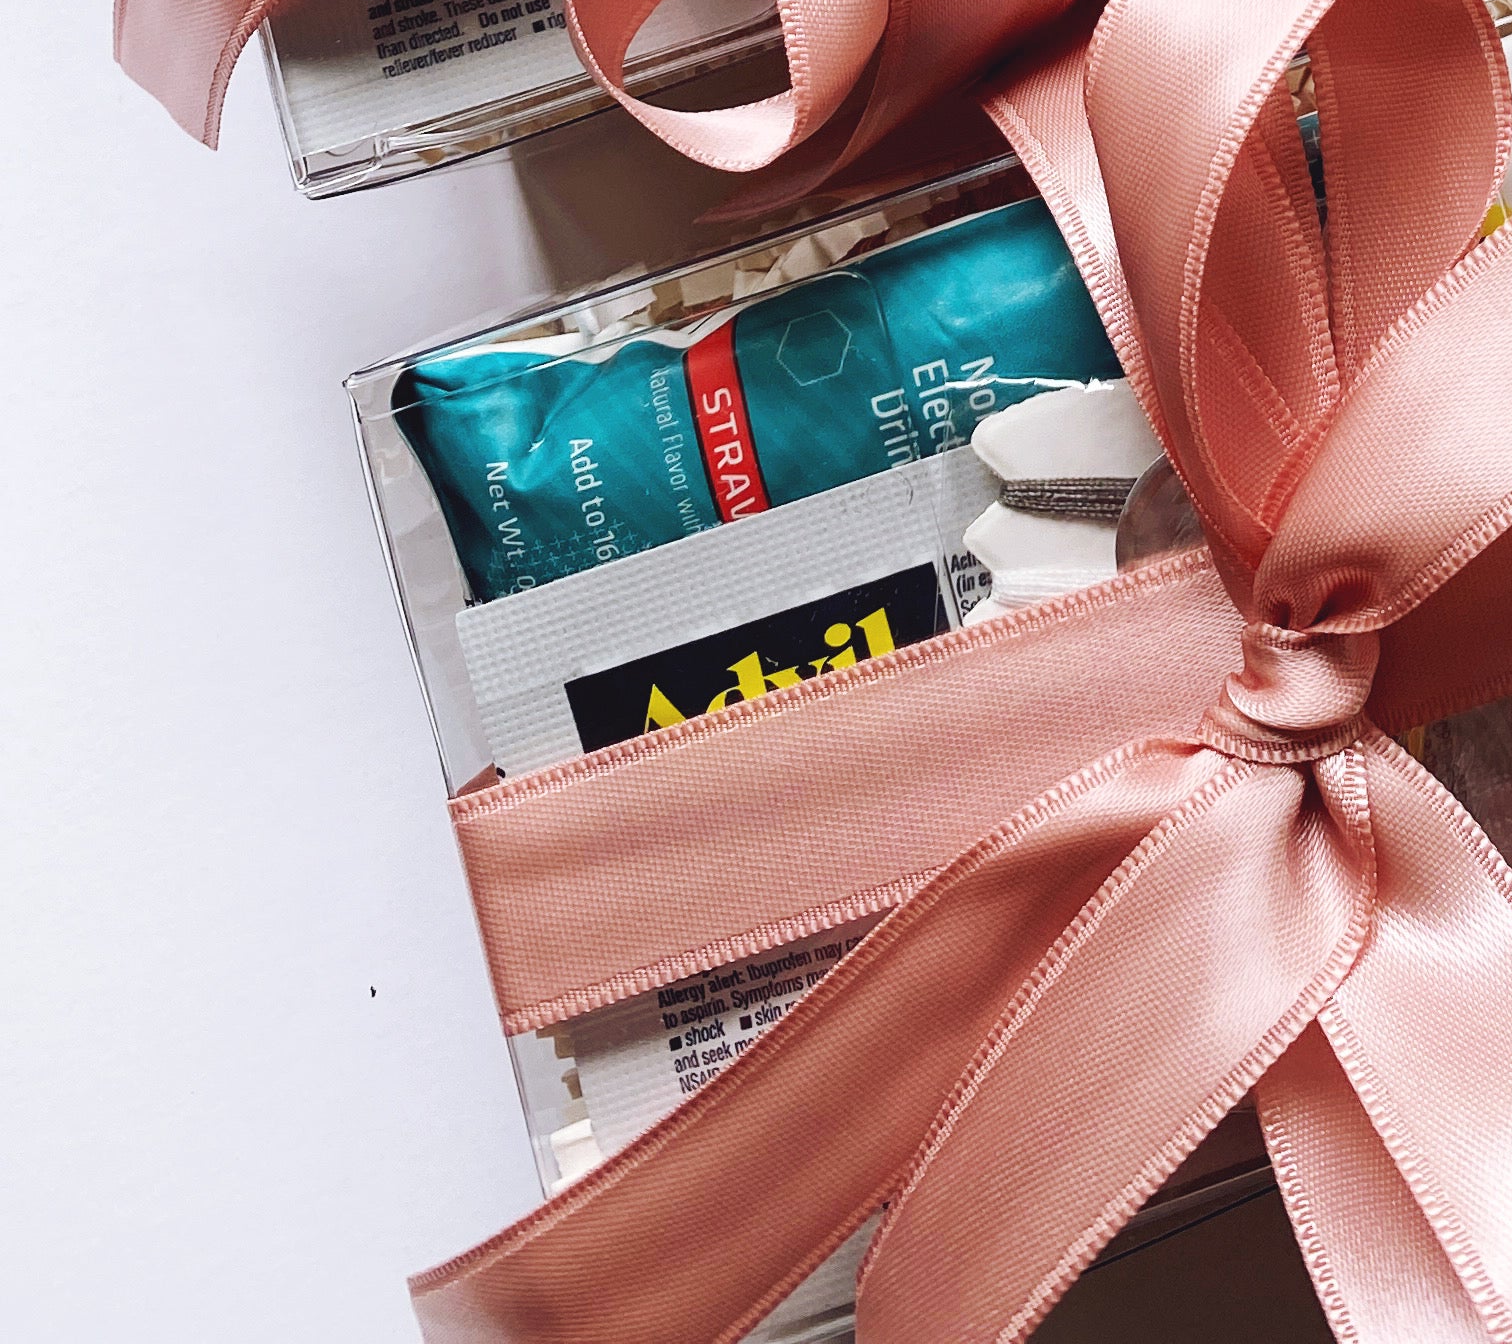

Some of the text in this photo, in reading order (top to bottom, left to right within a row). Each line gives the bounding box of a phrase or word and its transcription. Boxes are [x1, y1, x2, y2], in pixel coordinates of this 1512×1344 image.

[367, 1, 390, 19] and
[372, 20, 395, 39] and
[398, 7, 440, 31] stroke.
[409, 21, 462, 48] directed.
[479, 10, 498, 27] Do
[500, 2, 522, 20] not
[383, 26, 517, 77] reliever/fever reducer
[871, 388, 918, 468] Drin
[569, 438, 603, 492] Add
[662, 432, 689, 491] Flavor
[486, 462, 511, 513] Net
[582, 495, 606, 527] to
[955, 573, 976, 597] (in
[658, 939, 843, 1008] Allergy alert: Ibuprofen may
[681, 975, 803, 1023] aspirin. Symptoms
[684, 1003, 781, 1044] shock skin
[673, 1043, 730, 1072] and seek
